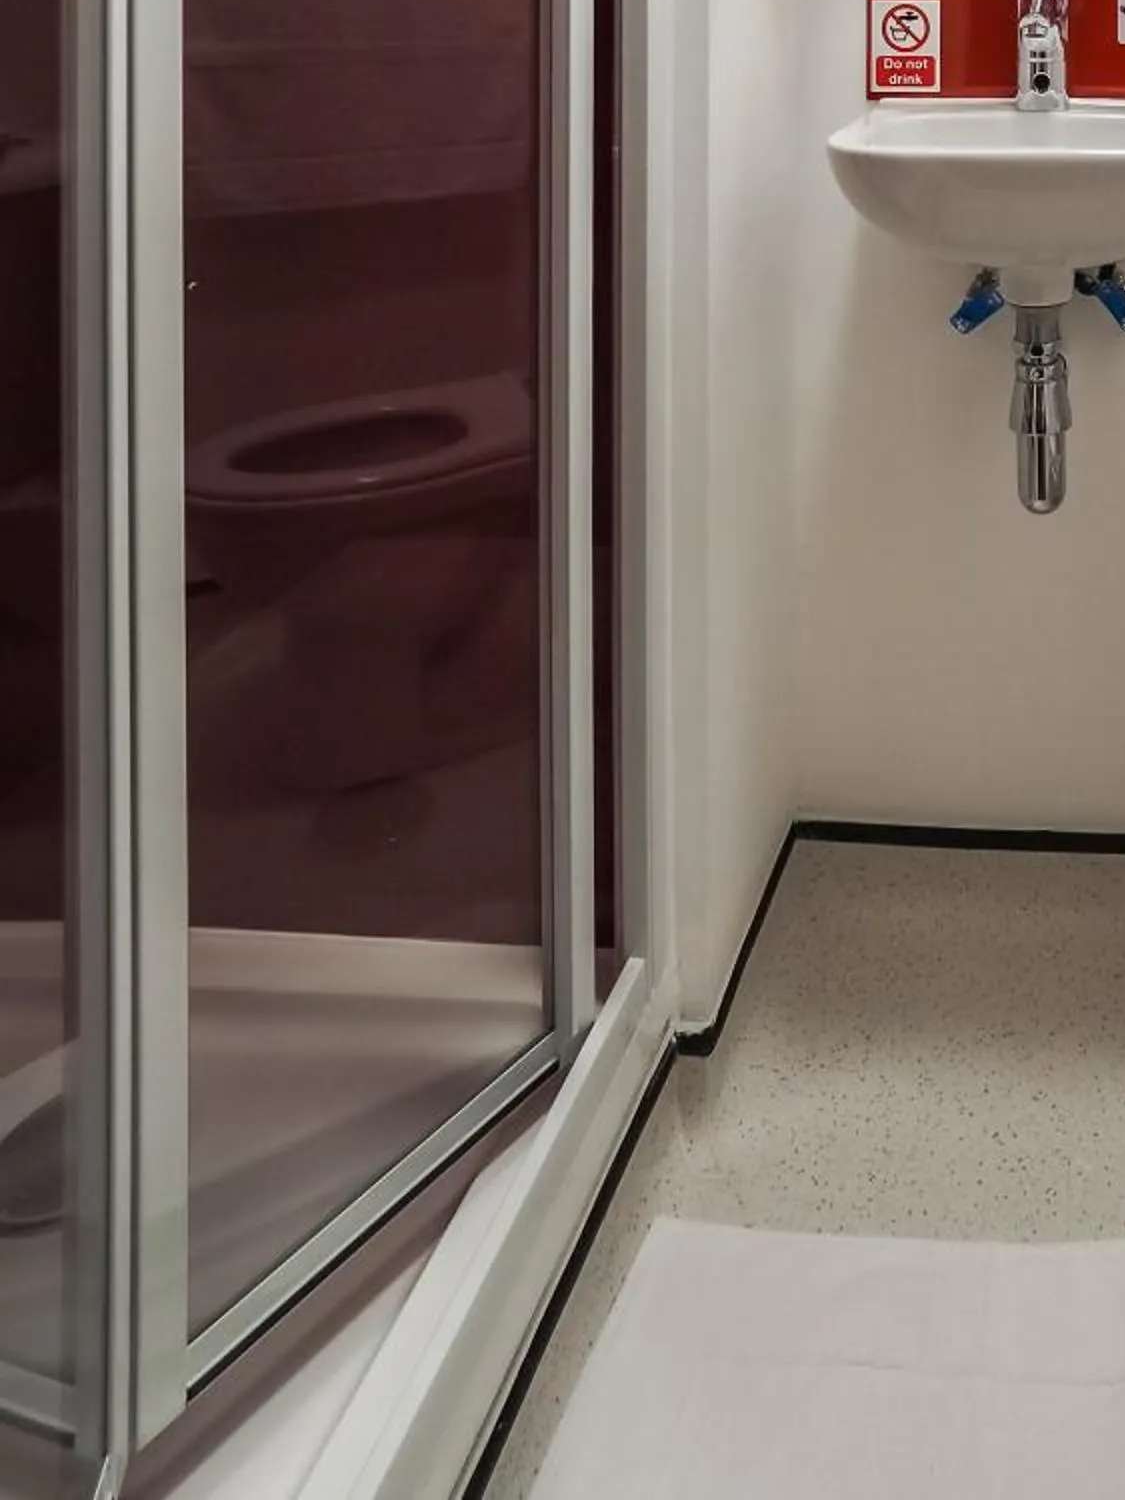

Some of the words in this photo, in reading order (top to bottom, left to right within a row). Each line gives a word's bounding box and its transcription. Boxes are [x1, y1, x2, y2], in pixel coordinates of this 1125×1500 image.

[883, 58, 902, 69] Do
[905, 58, 928, 69] not
[889, 73, 923, 85] drink
